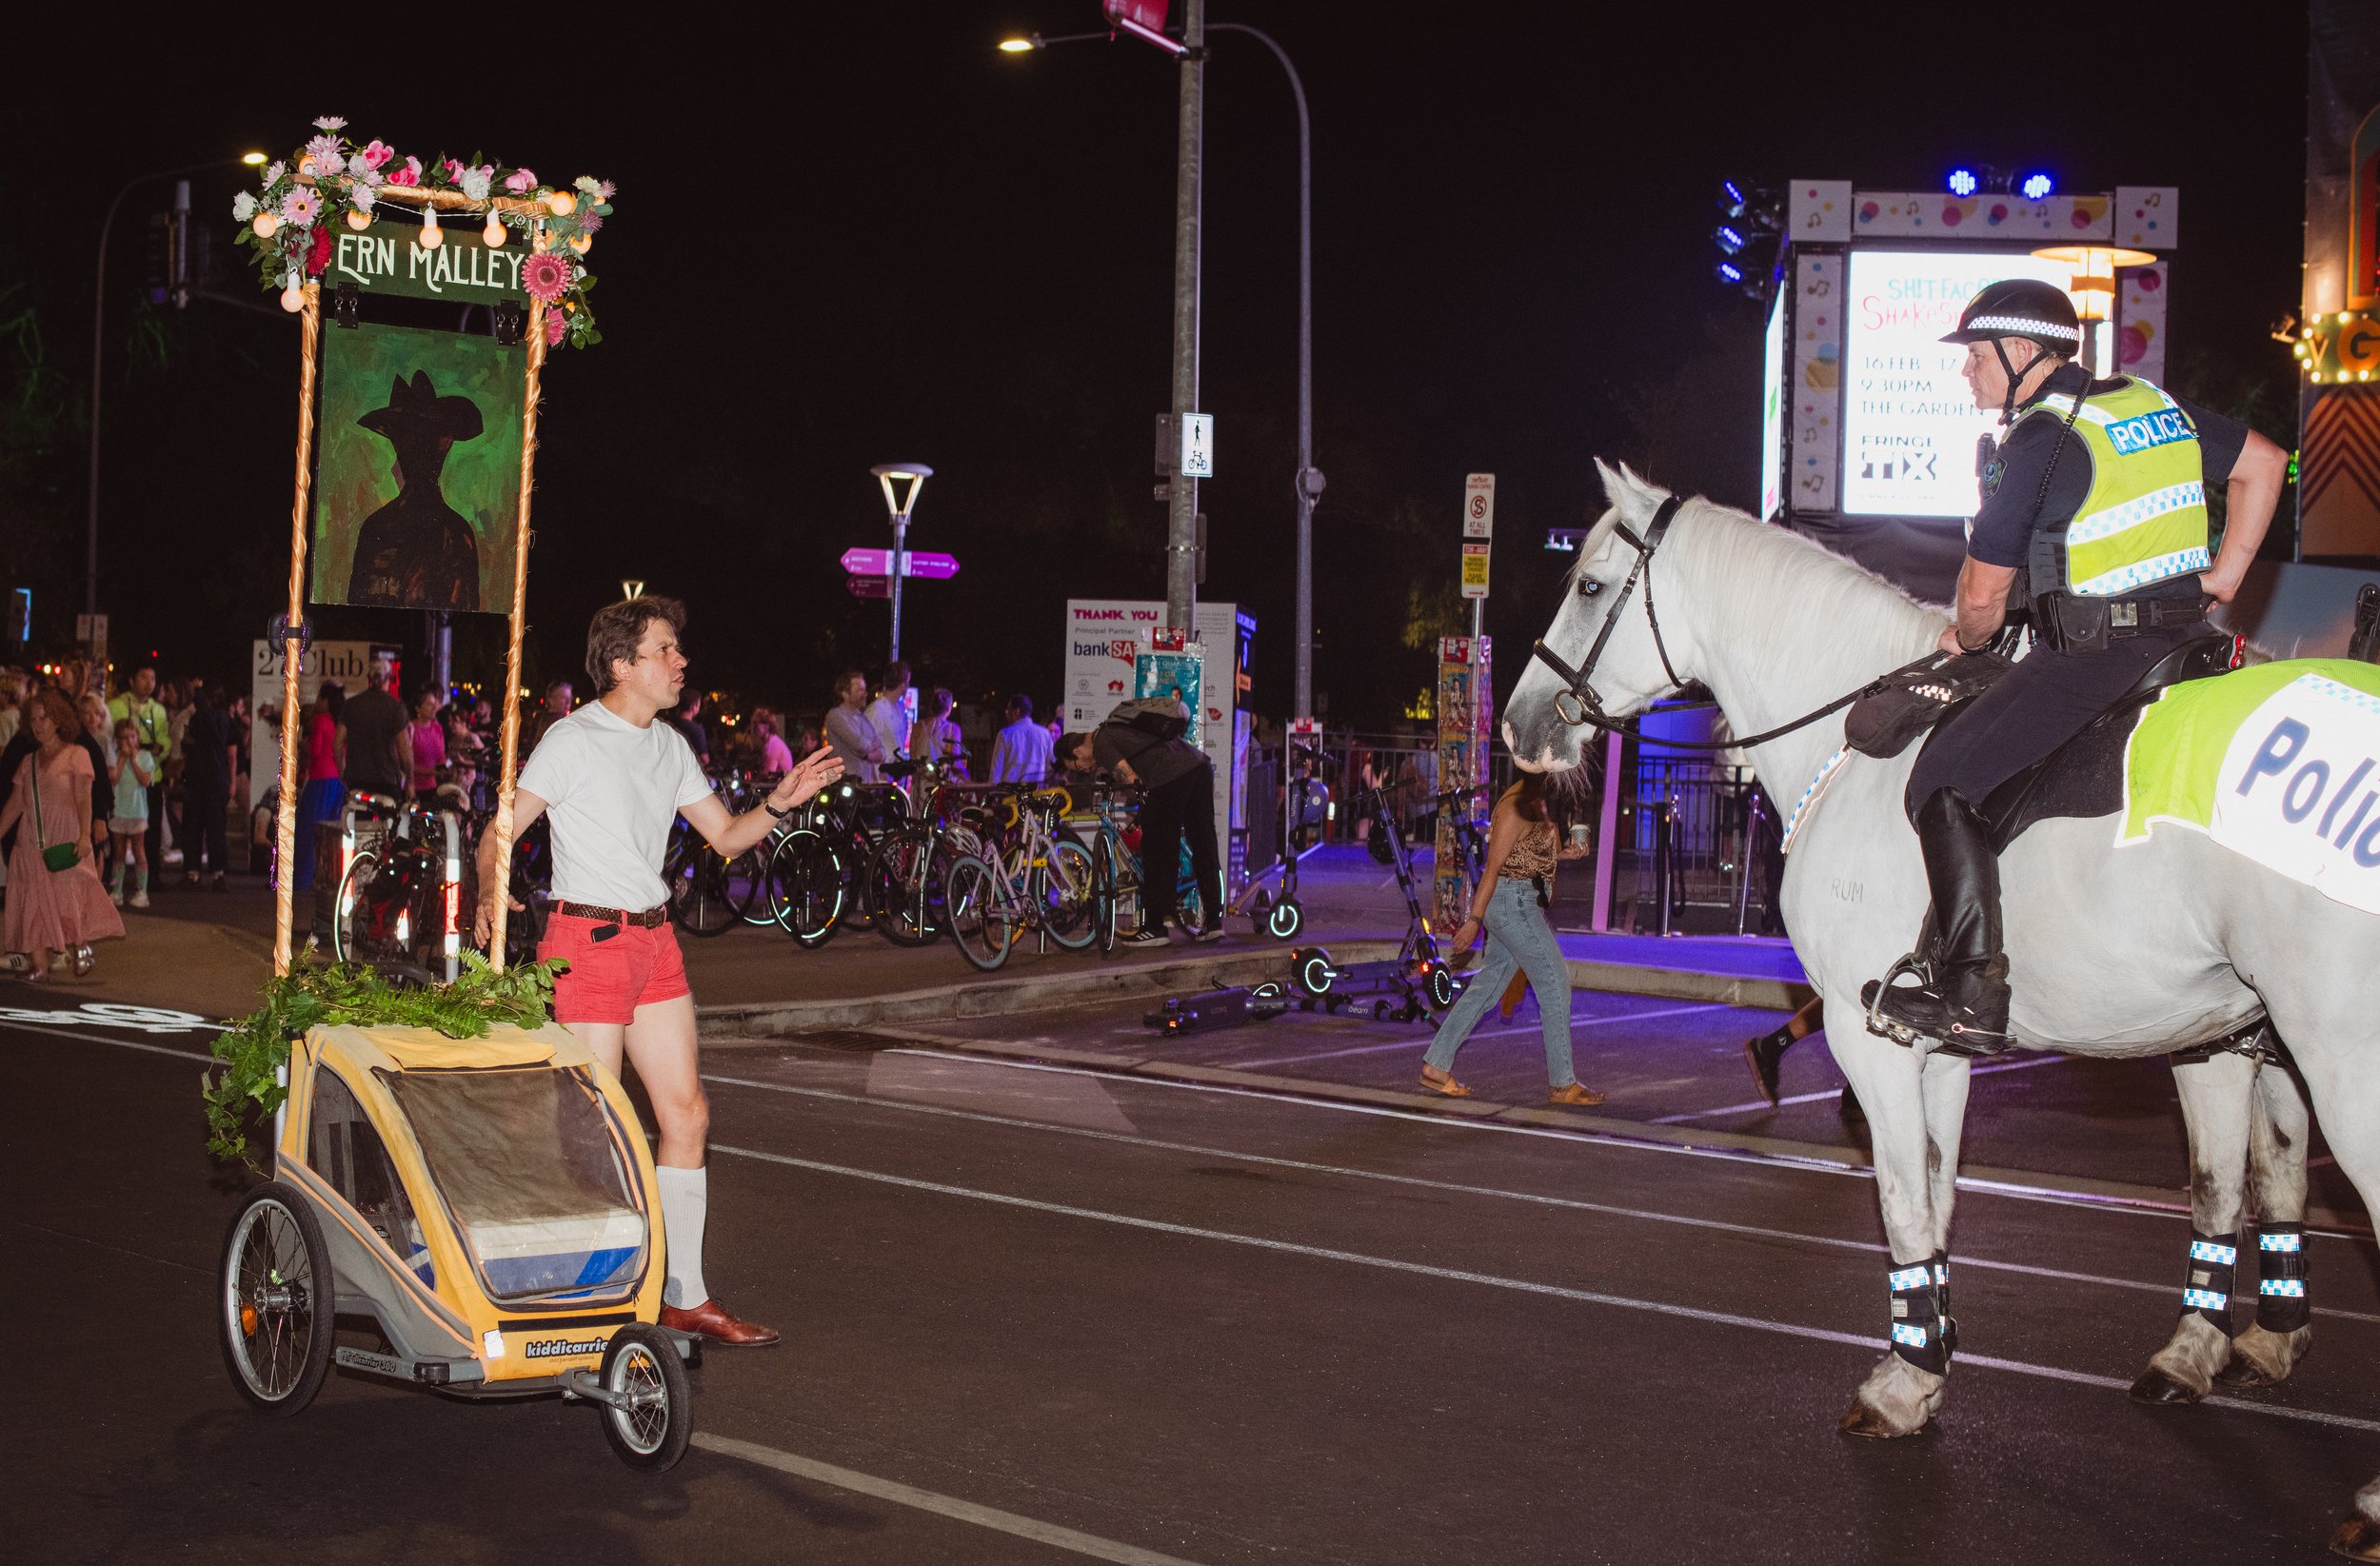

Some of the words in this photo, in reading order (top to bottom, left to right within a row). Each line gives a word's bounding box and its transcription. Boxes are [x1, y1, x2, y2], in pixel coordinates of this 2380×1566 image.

[338, 234, 395, 285] ERN
[409, 241, 525, 292] MALLEY
[1862, 401, 1891, 414] THE
[1900, 401, 1984, 416] GARDEN
[2111, 411, 2192, 450] POLICE
[1861, 435, 1933, 447] FRINGE
[1074, 608, 1125, 620] THANK
[1131, 610, 1158, 621] YOU
[1075, 626, 1107, 635] Principal
[301, 648, 364, 678] Club
[1830, 877, 1864, 904] RUM
[526, 1338, 609, 1358] kiddicarrie
